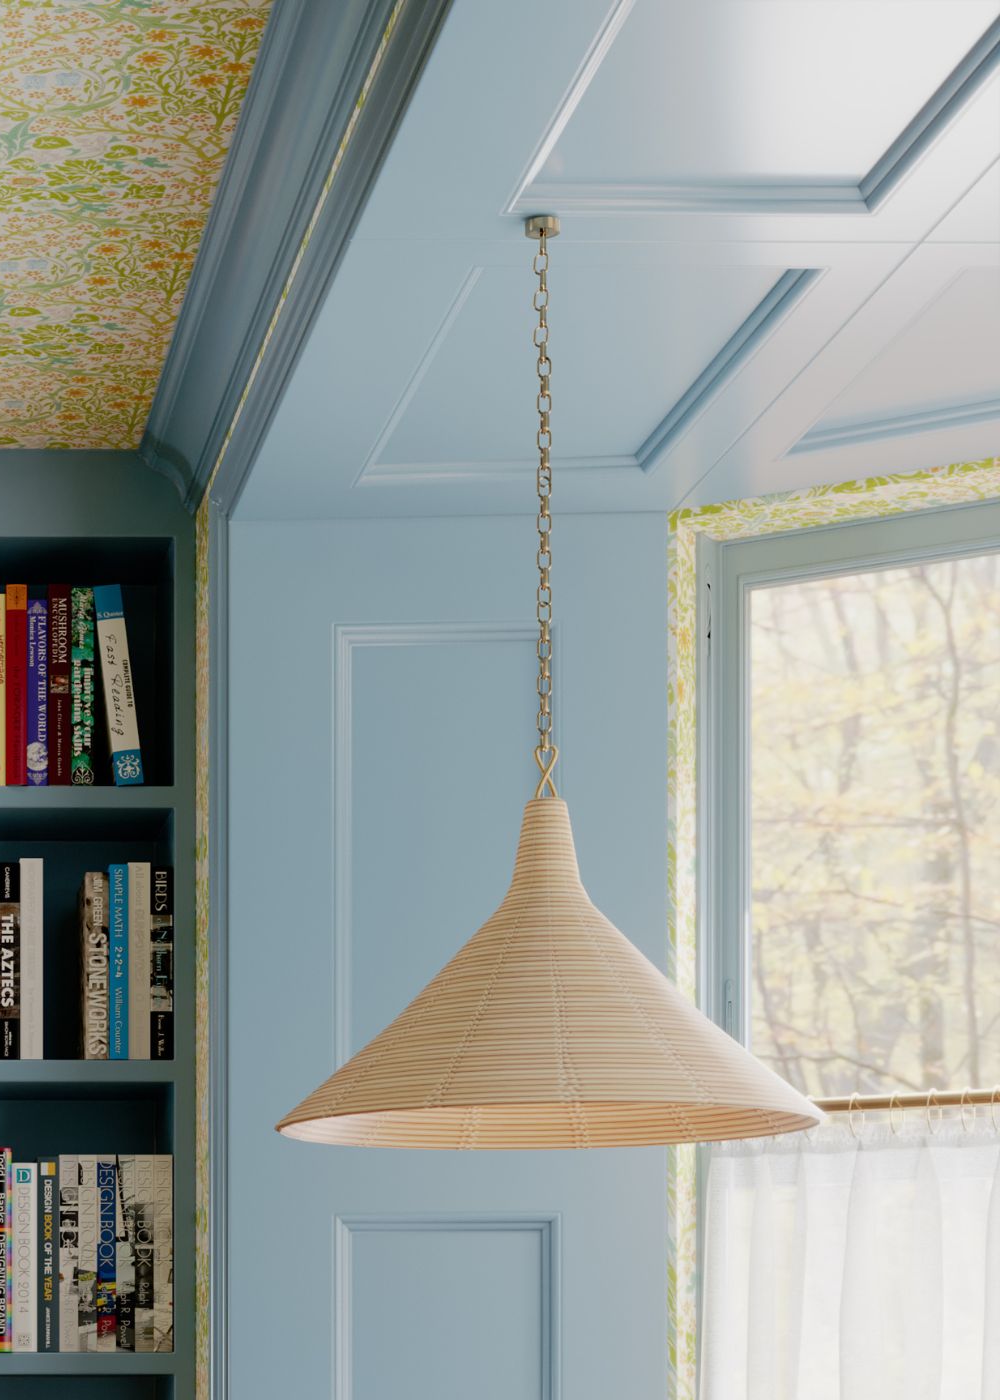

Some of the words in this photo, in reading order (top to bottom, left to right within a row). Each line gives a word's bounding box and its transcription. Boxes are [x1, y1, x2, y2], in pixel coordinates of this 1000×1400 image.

[38, 616, 46, 661] FLAVORS
[58, 598, 67, 663] MUSHROOM
[105, 635, 118, 666] Fast
[38, 664, 46, 677] OF
[38, 680, 46, 700] THE
[111, 674, 125, 735] Reading
[38, 705, 46, 741] WORLD
[1, 914, 14, 943] THE
[1, 948, 14, 1007] AZTECS
[44, 1180, 52, 1213] DESIGN
[99, 1162, 114, 1215] DESIGN
[44, 1214, 52, 1240] BOOK
[44, 1242, 52, 1255] OF
[99, 1221, 114, 1267] BOOK
[44, 1256, 52, 1274] THE
[44, 1276, 52, 1300] YEAR
